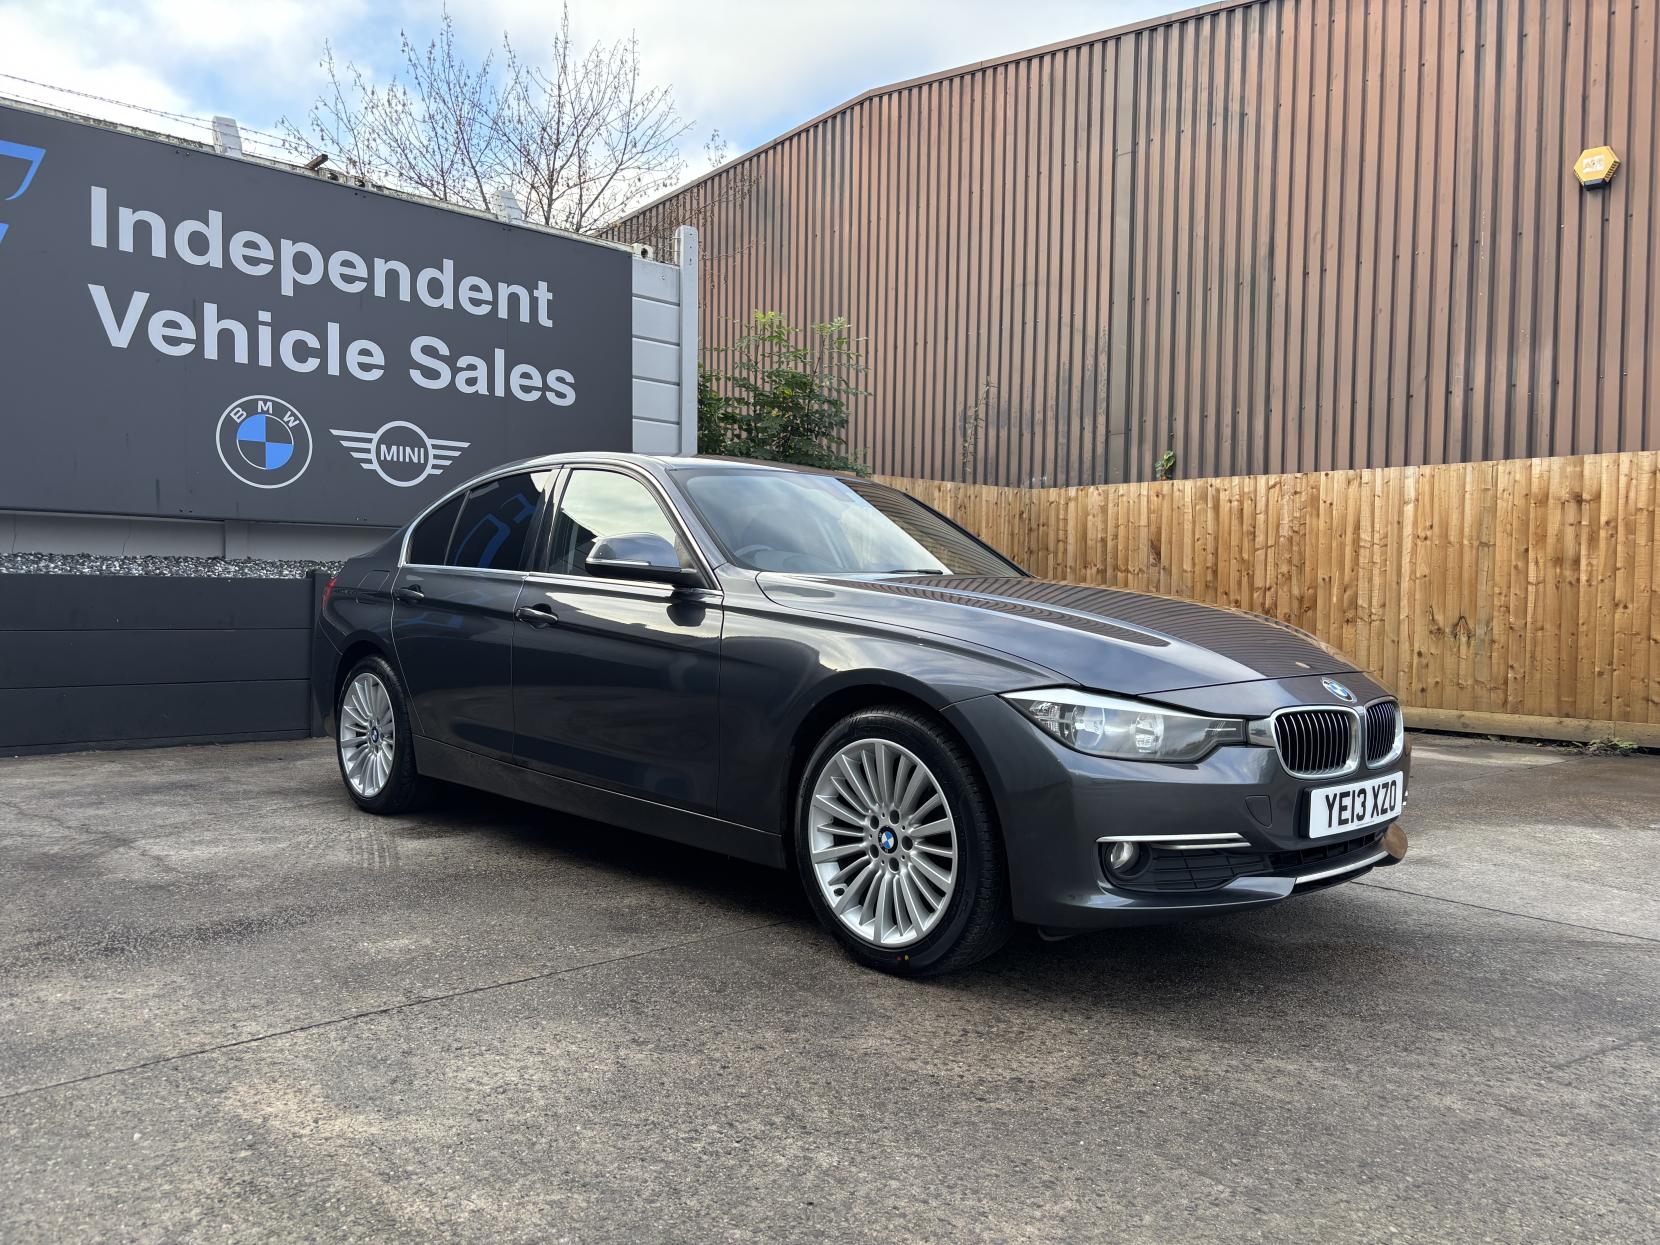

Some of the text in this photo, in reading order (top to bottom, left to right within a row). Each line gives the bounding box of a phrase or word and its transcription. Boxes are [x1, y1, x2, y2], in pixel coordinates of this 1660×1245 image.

[90, 185, 553, 328] Independent
[87, 283, 576, 407] Vehicle Sales
[229, 400, 300, 428] BMW
[380, 443, 425, 464] MINI
[1325, 779, 1397, 828] YE13 XZO
